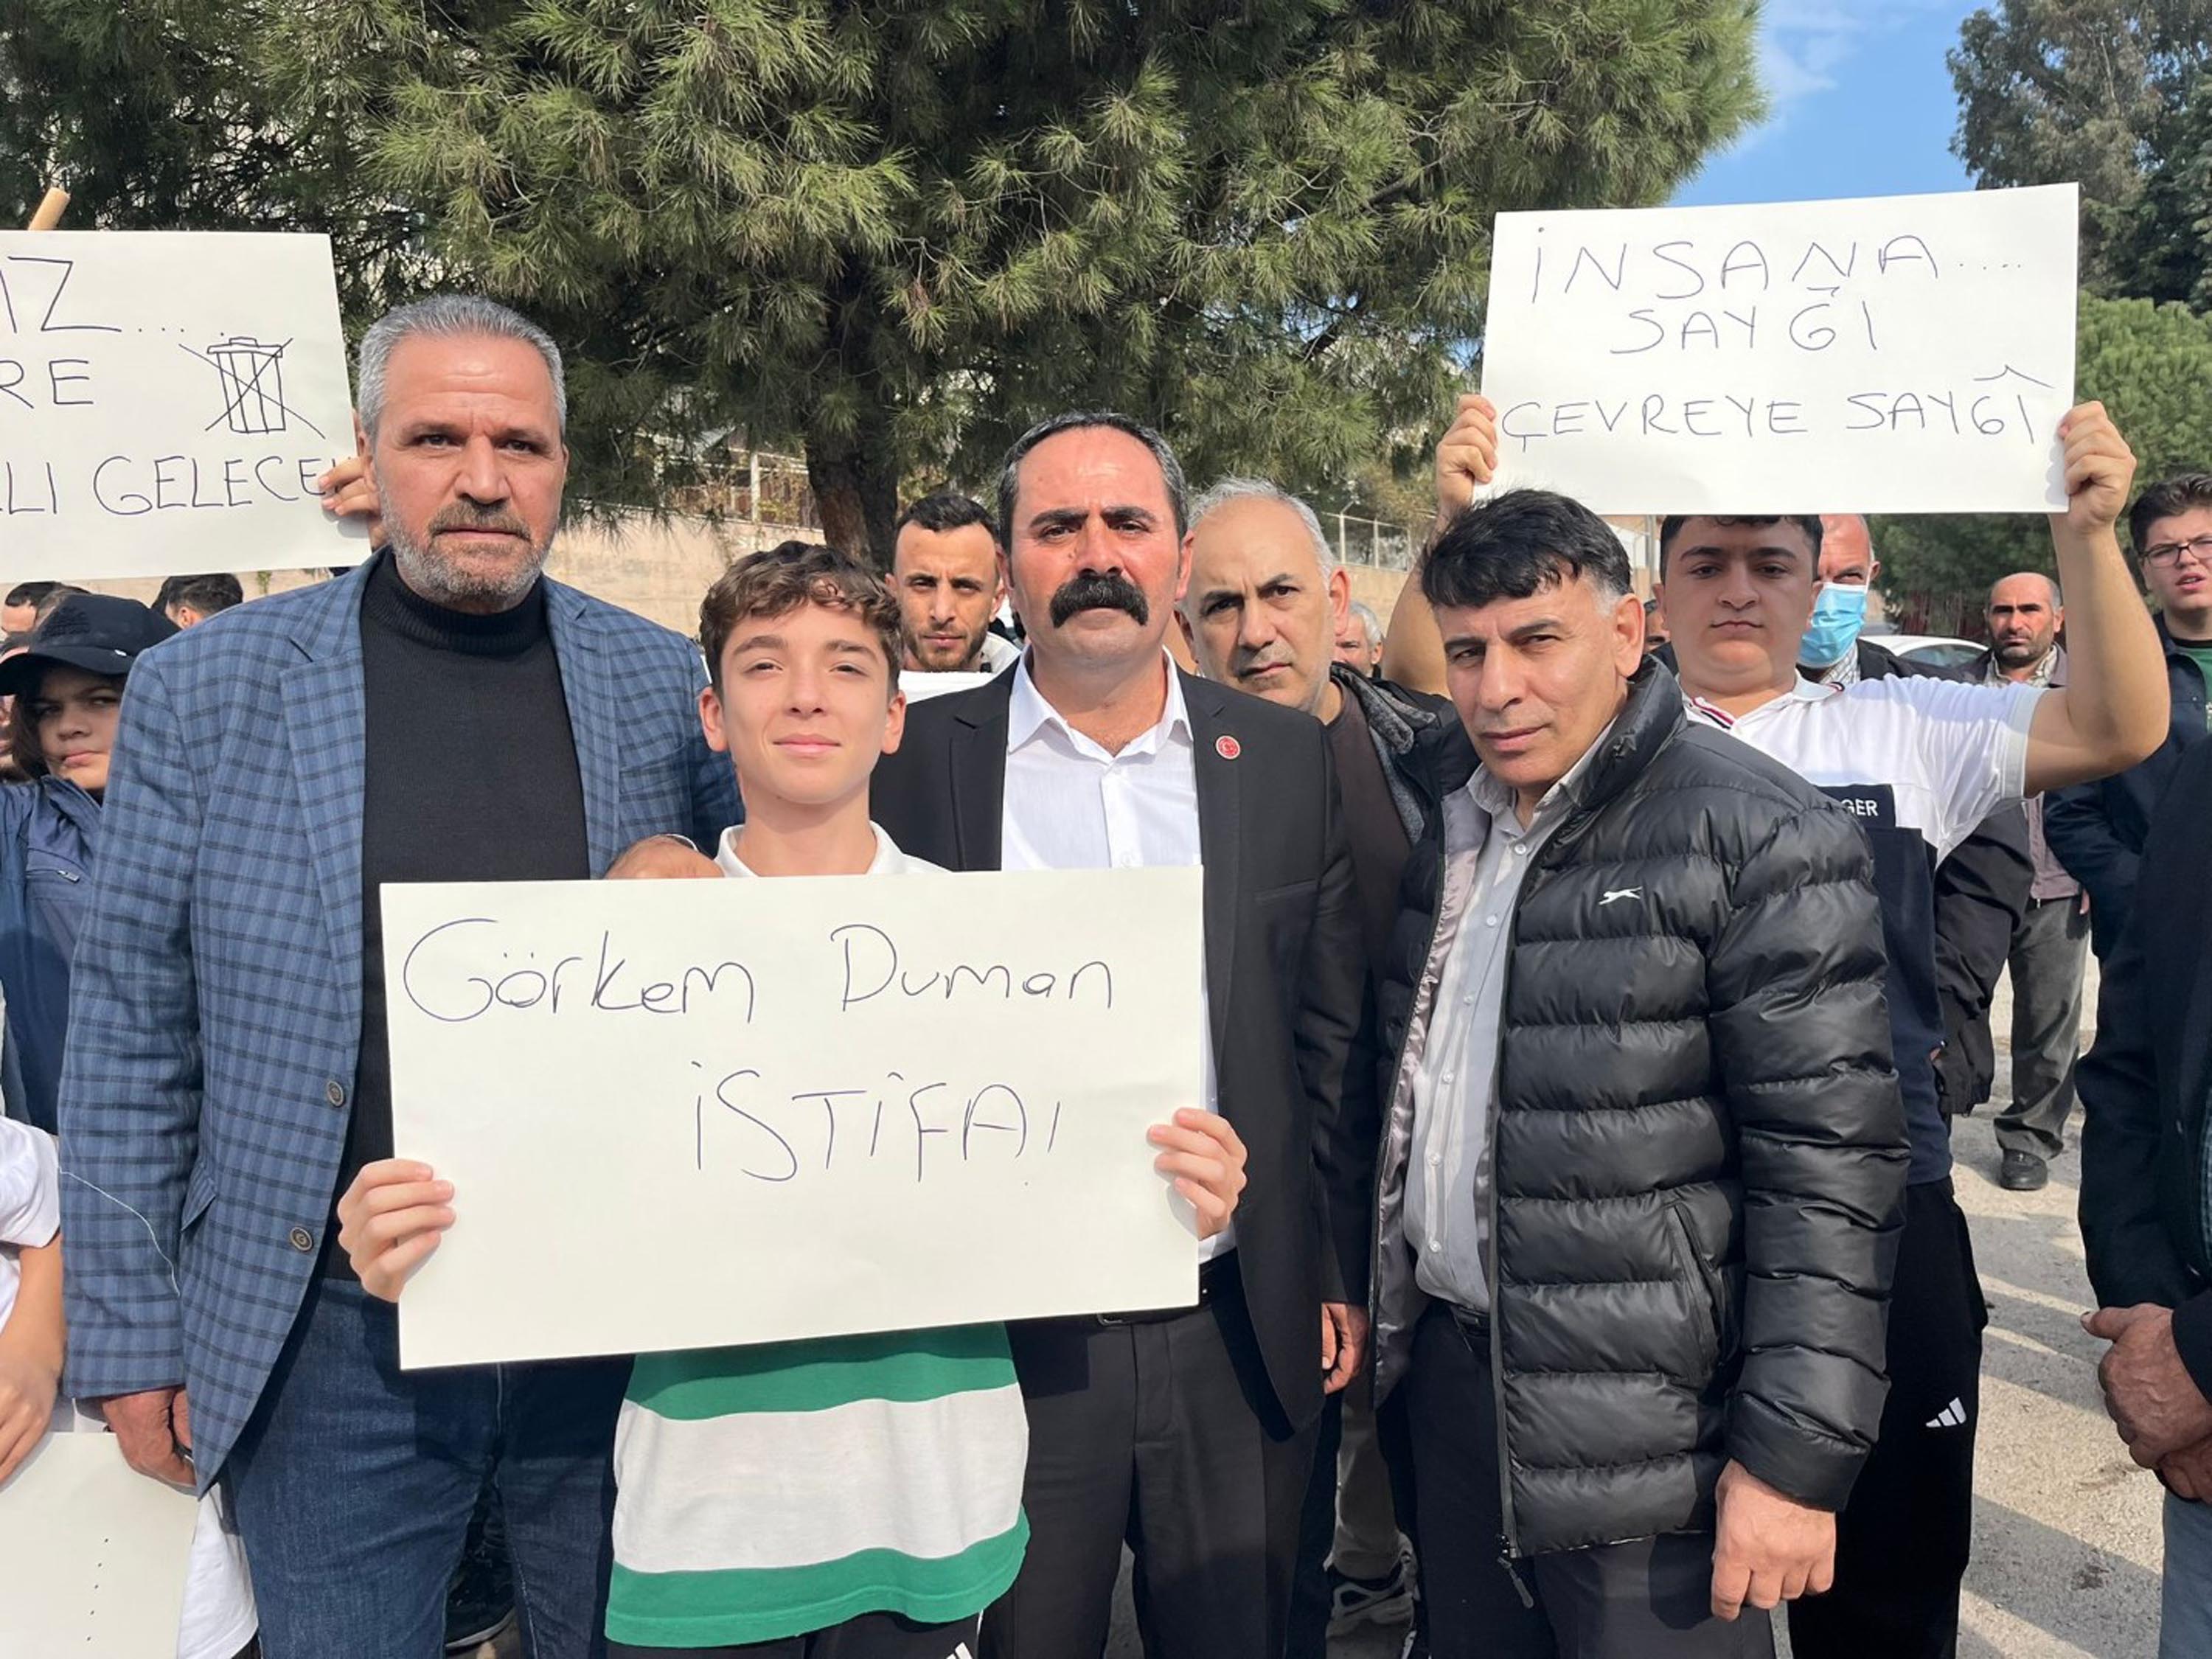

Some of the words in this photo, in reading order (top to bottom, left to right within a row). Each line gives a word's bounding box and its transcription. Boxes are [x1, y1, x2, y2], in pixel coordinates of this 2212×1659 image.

[1501, 394, 1809, 453] ÇEVREYE
[403, 917, 755, 1023] Görkem
[829, 924, 1113, 1012] Duman
